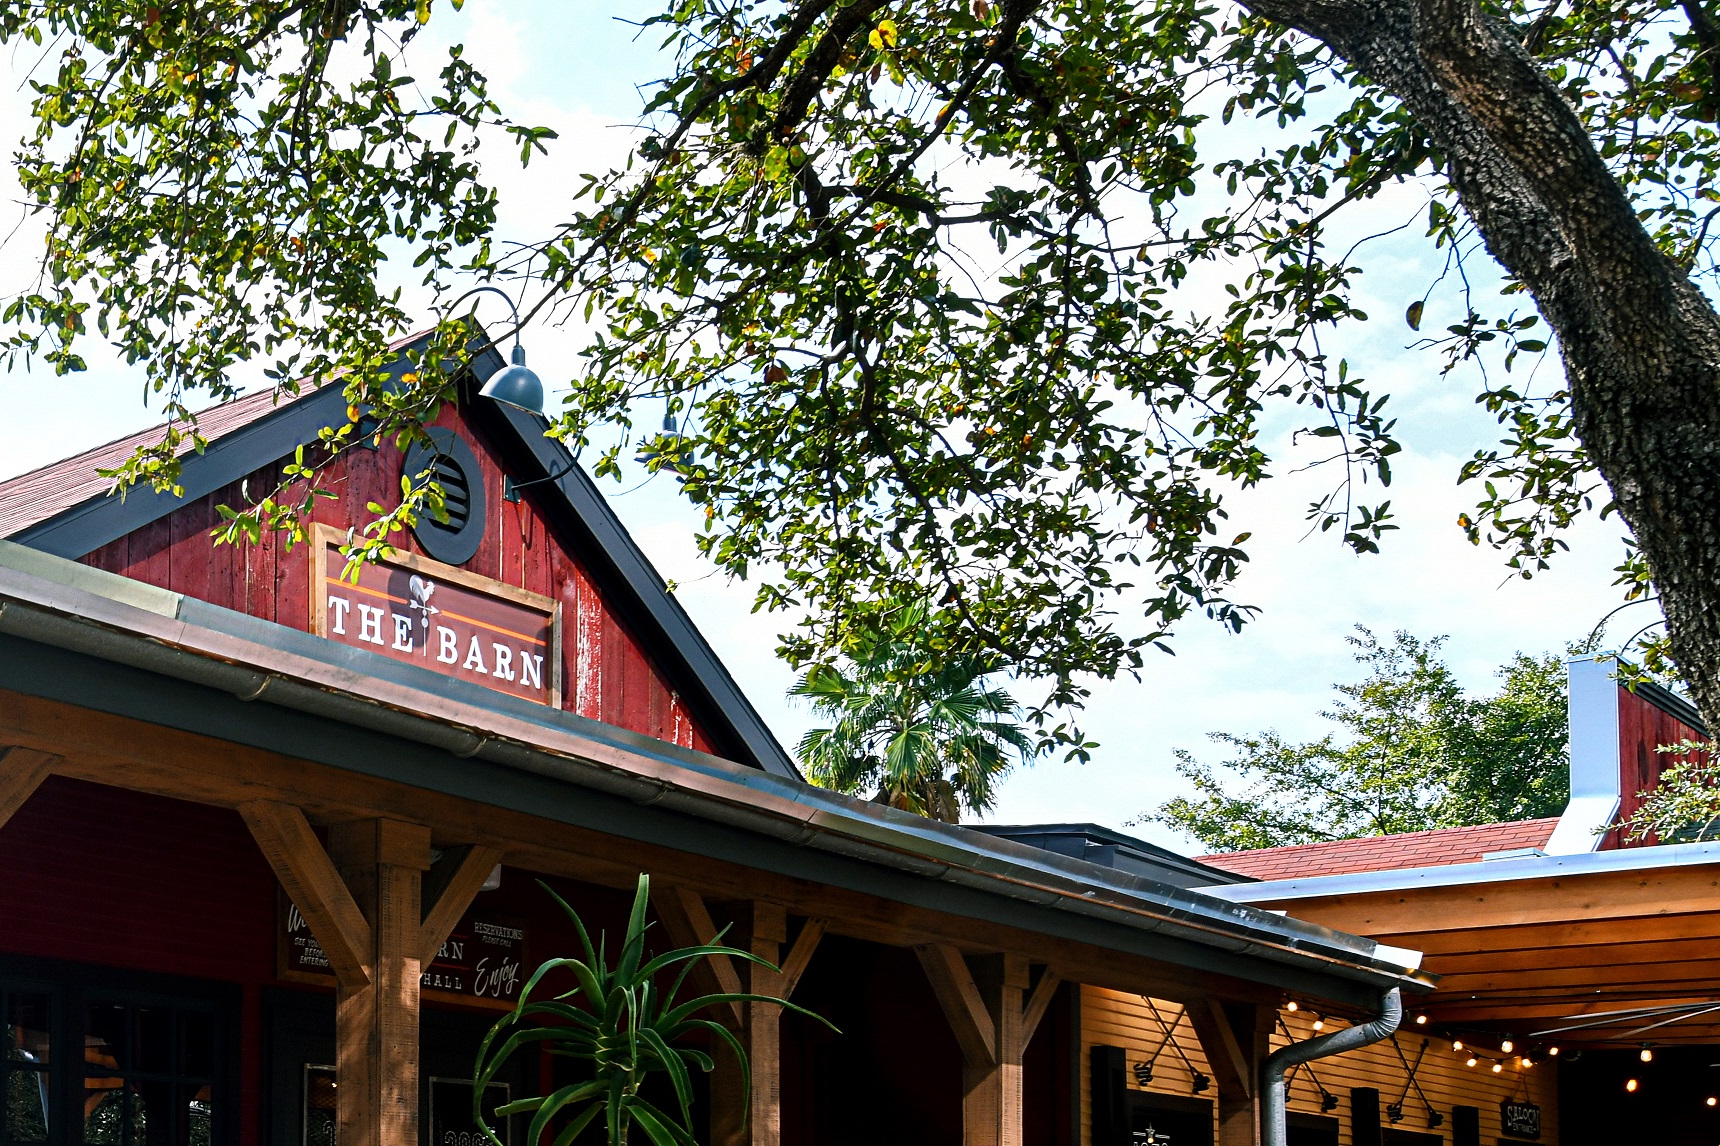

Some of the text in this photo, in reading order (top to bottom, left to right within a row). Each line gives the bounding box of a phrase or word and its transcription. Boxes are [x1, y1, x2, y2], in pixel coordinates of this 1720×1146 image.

[328, 595, 544, 689] THE BARN
[474, 922, 523, 940] RESERVATIONS
[438, 941, 464, 960] RN
[423, 973, 462, 990] HALL
[474, 957, 520, 998] Enjoy
[1507, 1105, 1540, 1131] SALOON
